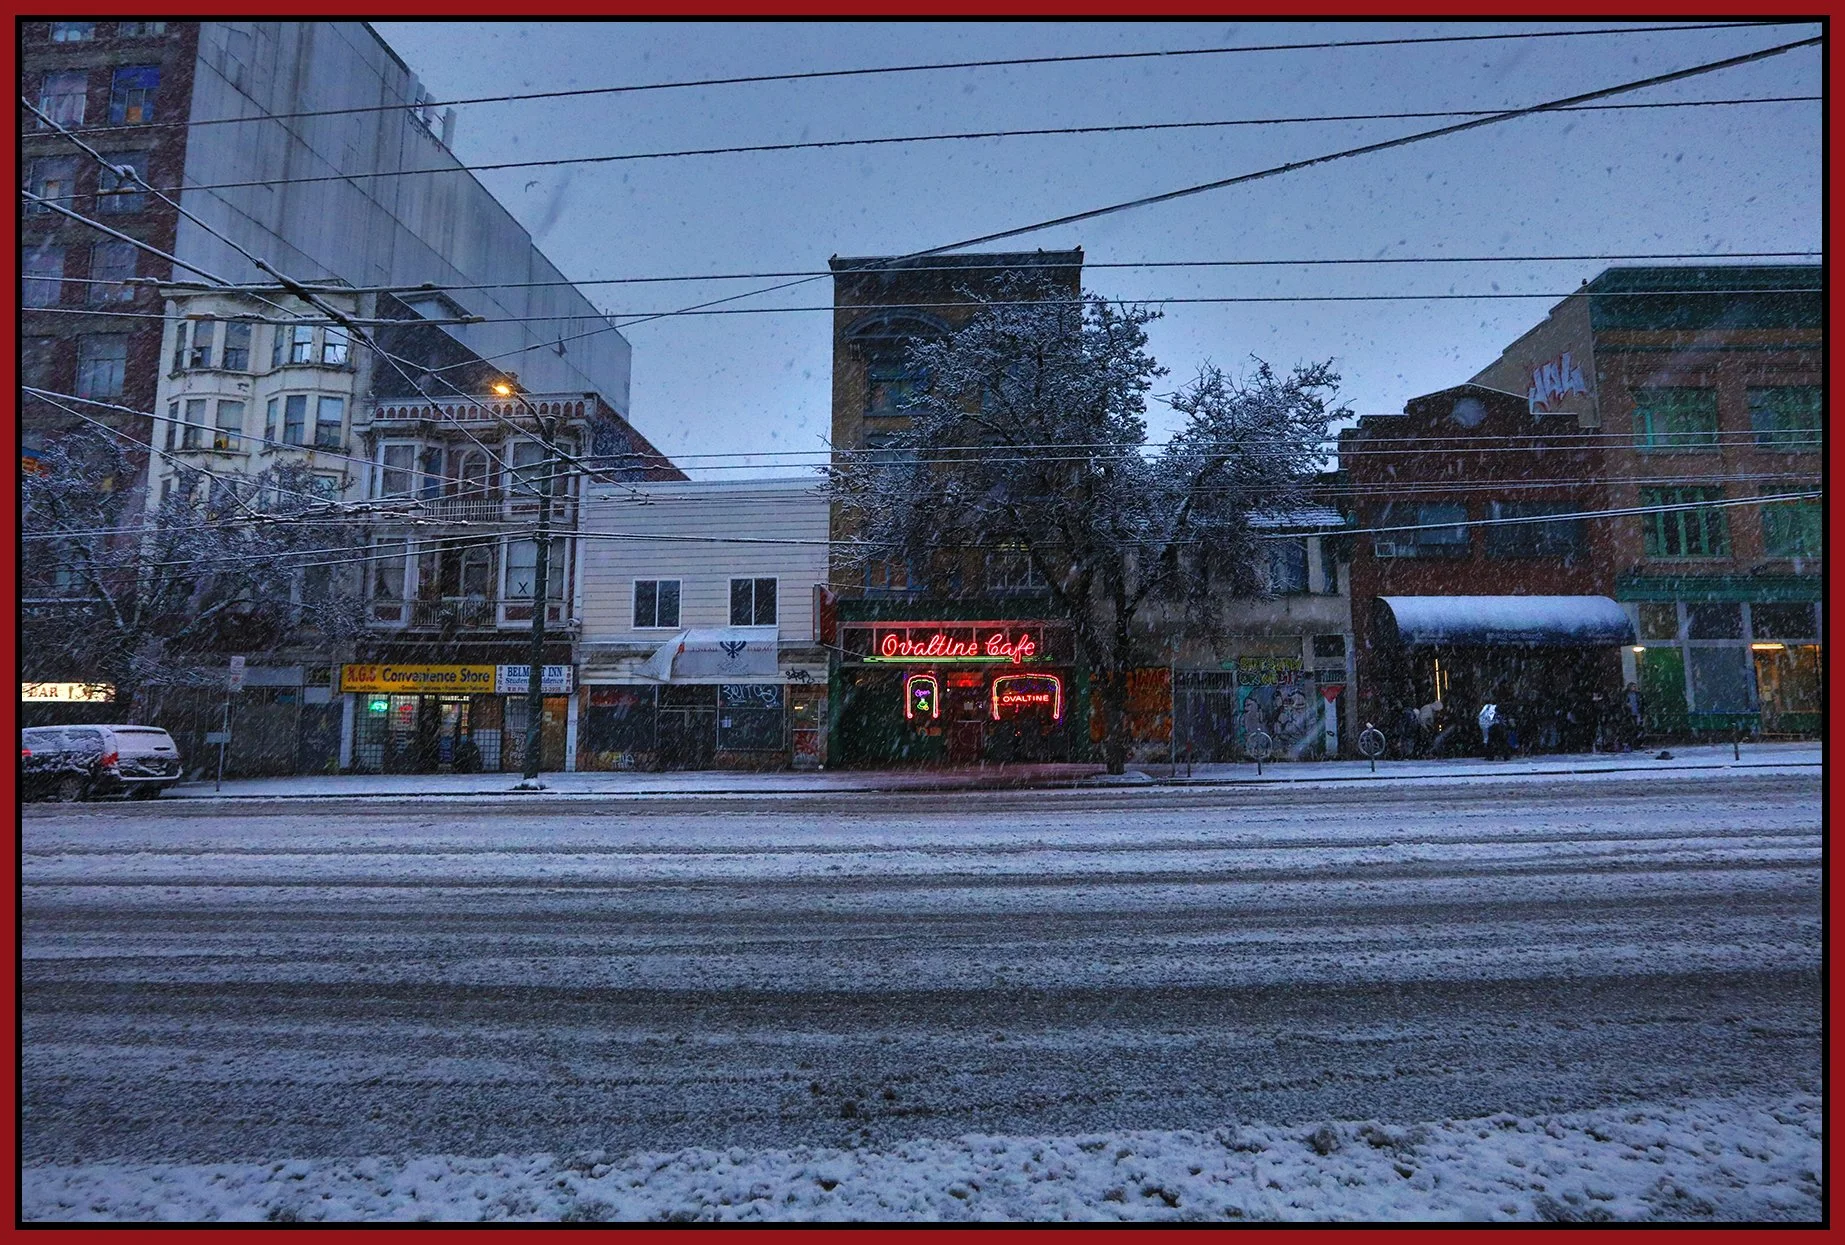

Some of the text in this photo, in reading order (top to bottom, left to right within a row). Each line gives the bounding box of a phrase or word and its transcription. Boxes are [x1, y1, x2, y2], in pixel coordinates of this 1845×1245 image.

[881, 633, 1036, 664] Ovaltine Cafe
[382, 667, 457, 683] Convenience
[460, 667, 490, 682] Store
[507, 666, 563, 677] BELMT INN
[505, 677, 528, 685] Studen
[914, 688, 931, 698] Open
[1002, 694, 1050, 703] OVALTINE
